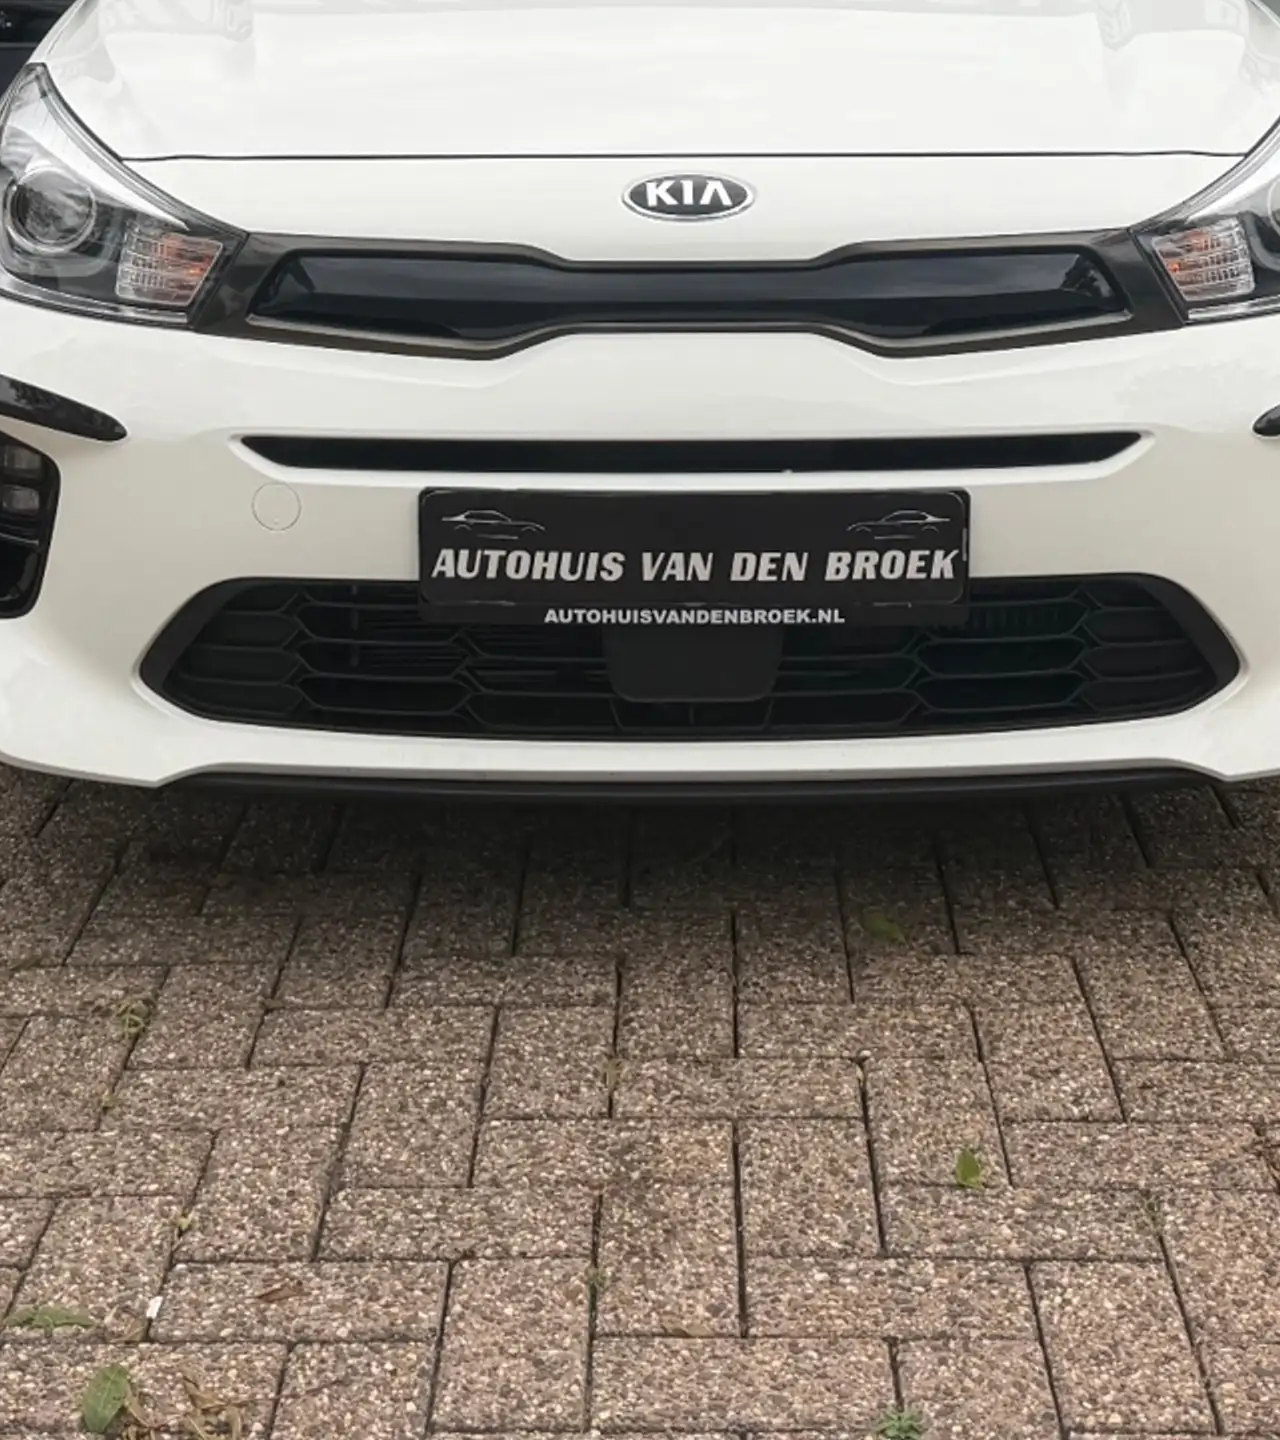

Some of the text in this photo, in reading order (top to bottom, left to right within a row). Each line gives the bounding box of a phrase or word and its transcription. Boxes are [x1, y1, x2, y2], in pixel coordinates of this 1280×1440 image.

[646, 180, 733, 207] KIA
[431, 548, 959, 582] AUTOHUIS VAN DEN BROEK
[543, 608, 846, 624] AUTOHUISVANDENBROEK.NL
